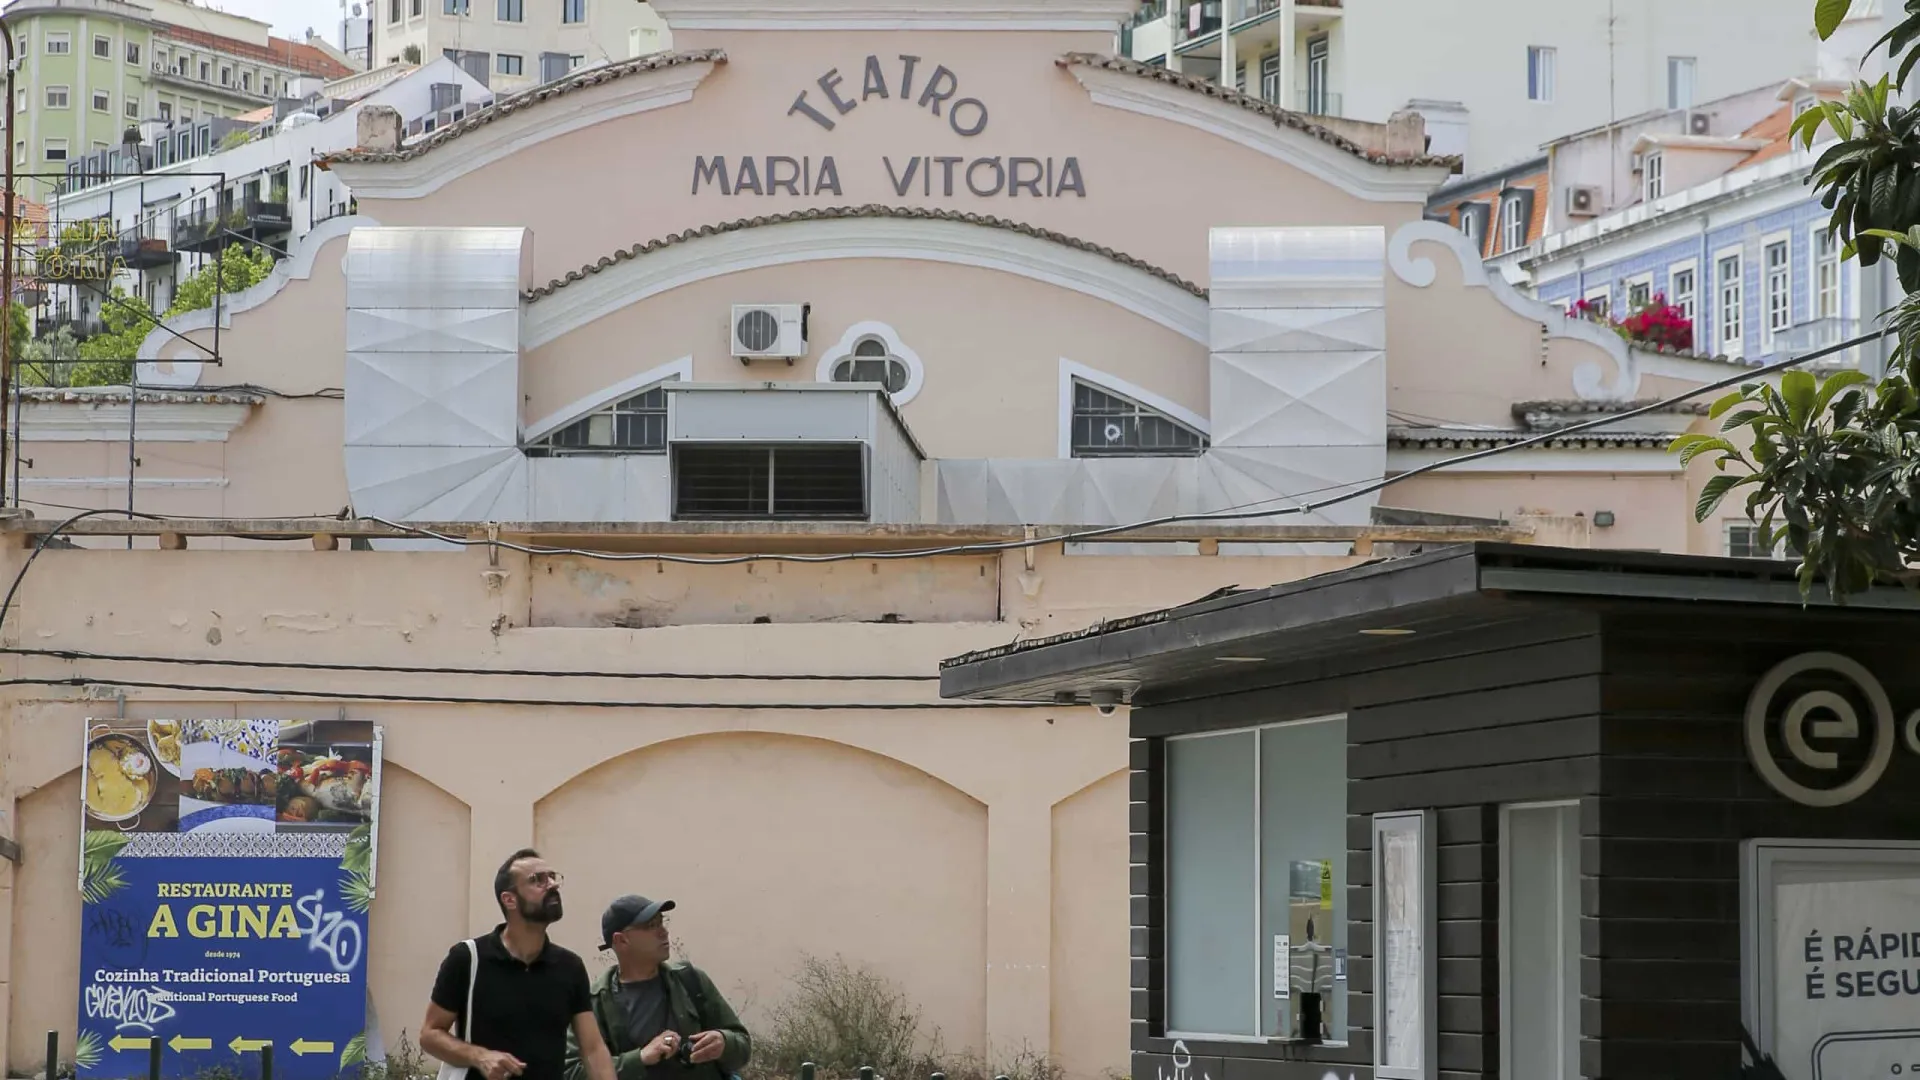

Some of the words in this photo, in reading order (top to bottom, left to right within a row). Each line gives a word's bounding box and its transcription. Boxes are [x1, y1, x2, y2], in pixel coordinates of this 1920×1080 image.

[788, 55, 988, 136] TEATRO
[692, 155, 842, 195] MARIA
[883, 155, 1086, 197] VITÓRIA
[157, 883, 293, 898] RESTAURANTE
[147, 904, 179, 938] A
[187, 904, 301, 939] GINA
[226, 951, 240, 959] 1974
[1804, 928, 1824, 963] É
[95, 969, 159, 983] Cozinha
[162, 969, 254, 983] Tradicional
[258, 970, 350, 988] Portuguesa
[1806, 966, 1825, 999] É
[208, 992, 269, 1004] Portuguese
[271, 992, 298, 1002] Food
